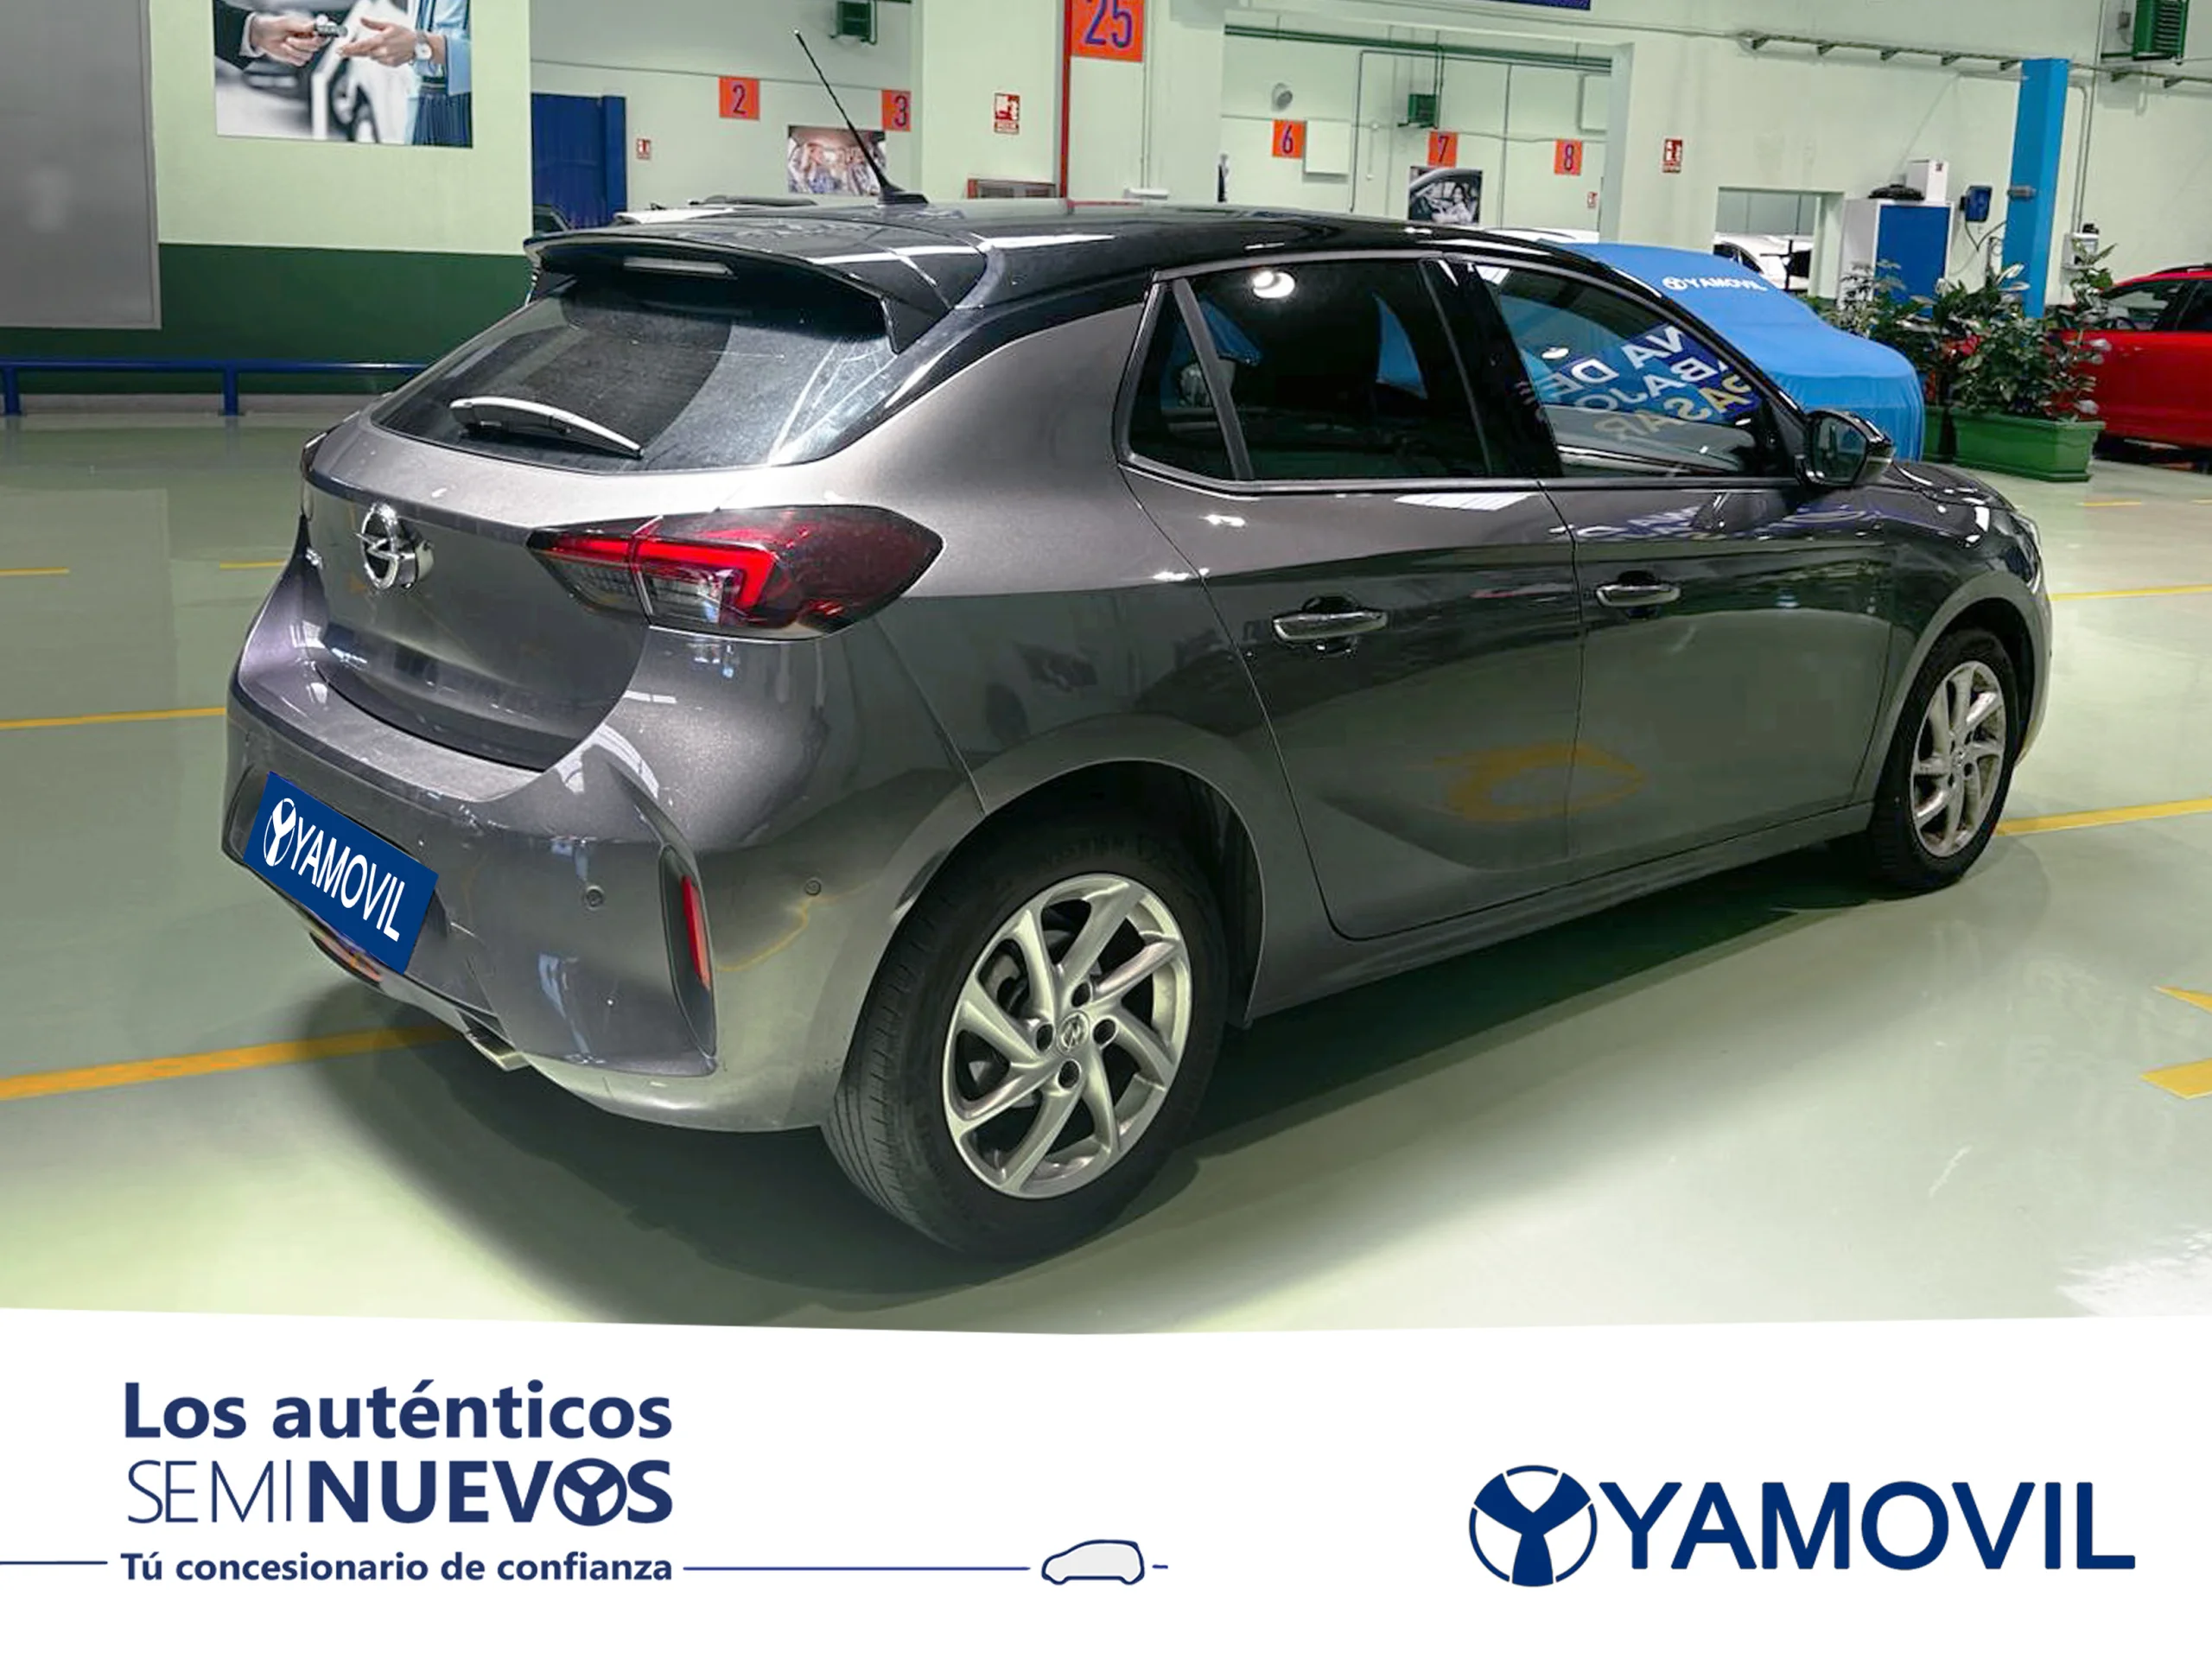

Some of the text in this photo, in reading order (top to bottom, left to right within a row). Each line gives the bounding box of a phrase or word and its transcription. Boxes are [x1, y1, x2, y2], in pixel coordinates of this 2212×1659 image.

[1084, 0, 1133, 48] 25
[733, 83, 747, 115] 2
[893, 94, 908, 128] 3
[1281, 124, 1294, 155] 6
[1436, 135, 1449, 163] 7
[1563, 143, 1575, 172] 8
